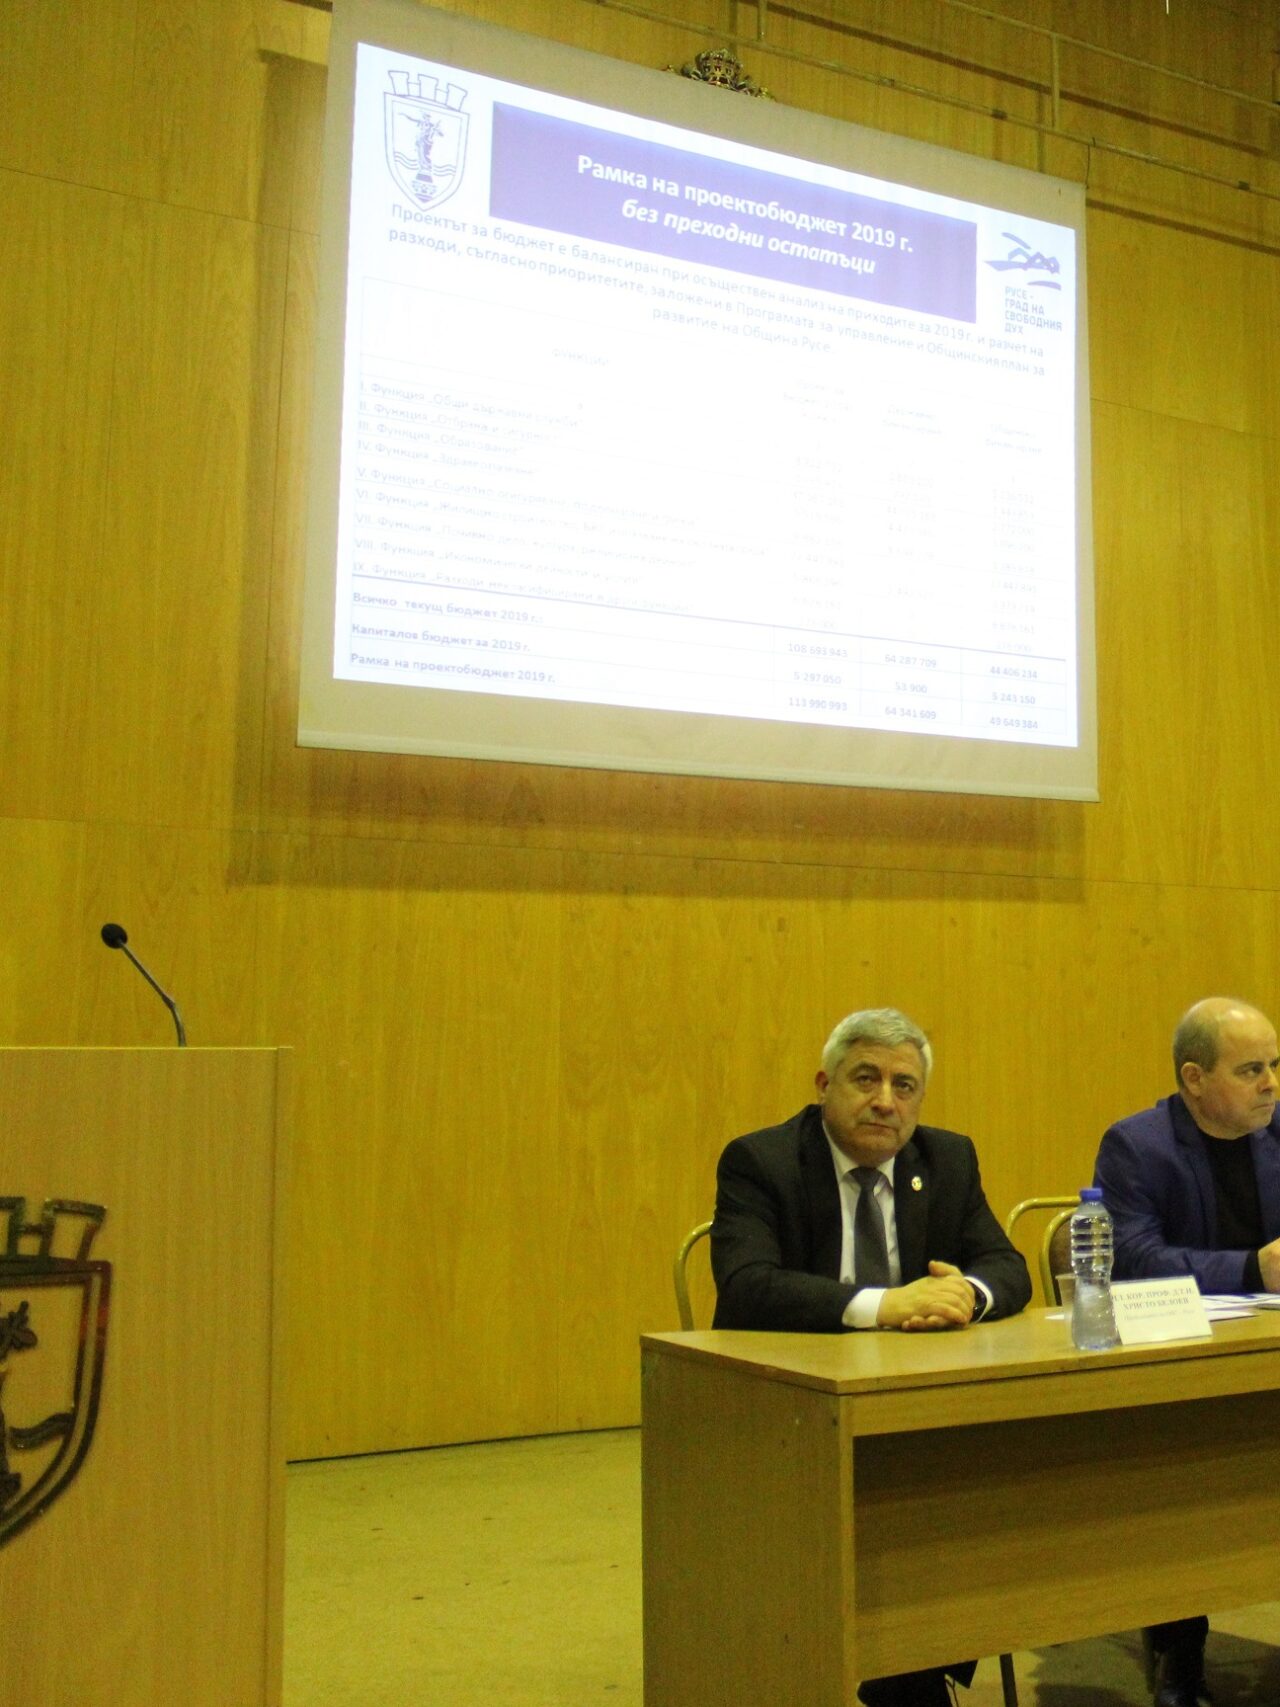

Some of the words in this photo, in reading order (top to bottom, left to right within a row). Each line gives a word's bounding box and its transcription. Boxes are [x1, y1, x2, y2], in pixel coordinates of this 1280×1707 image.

[577, 154, 647, 189] Рамка
[652, 176, 679, 198] на
[683, 179, 847, 241] проектобюджет
[850, 220, 895, 249] 2019
[899, 235, 913, 253] г.
[621, 196, 658, 225] без
[662, 206, 764, 253] преходни
[767, 235, 875, 278] остатъци
[391, 203, 468, 235] Проектът
[471, 224, 488, 238] за
[493, 225, 554, 255] бюджет
[558, 243, 567, 255] е
[570, 243, 659, 277] балансиран
[661, 266, 689, 285] при
[692, 273, 776, 303] осъществен
[778, 291, 824, 311] анализ
[827, 302, 844, 315] на
[846, 306, 915, 333] приходите
[918, 322, 931, 334] за
[977, 334, 985, 345] и
[988, 336, 1027, 356] разчет
[1029, 345, 1044, 358] на
[1004, 284, 1027, 300] РУСЕ
[388, 227, 461, 256] разходи,
[465, 244, 537, 272] съгласно
[538, 260, 648, 295] приоритетите,
[650, 284, 722, 310] заложени
[725, 300, 732, 312] в
[736, 300, 814, 331] Програмата
[819, 320, 833, 333] за
[838, 324, 913, 351] управление
[916, 340, 924, 352] и
[926, 340, 999, 369] Общинския
[1001, 358, 1029, 374] план
[1032, 364, 1045, 377] за
[1004, 296, 1028, 313] ГРАД
[1031, 302, 1044, 316] НА
[652, 306, 718, 332] развитие
[722, 321, 739, 335] на
[742, 322, 797, 348] Община
[1004, 308, 1062, 333] СВОБОДНИЯ
[1004, 320, 1023, 336] ДУХ
[352, 592, 397, 607] Всичко
[403, 599, 443, 614] текущ
[446, 602, 498, 620] бюджет
[500, 609, 528, 622] 2019
[350, 623, 418, 641] Капиталов
[421, 630, 472, 647] бюджет
[475, 637, 488, 648] за
[491, 638, 521, 651] 2019
[349, 652, 390, 667] Рамка
[394, 658, 409, 669] на
[412, 658, 515, 681] проектобюджет
[517, 669, 545, 682] 2019
